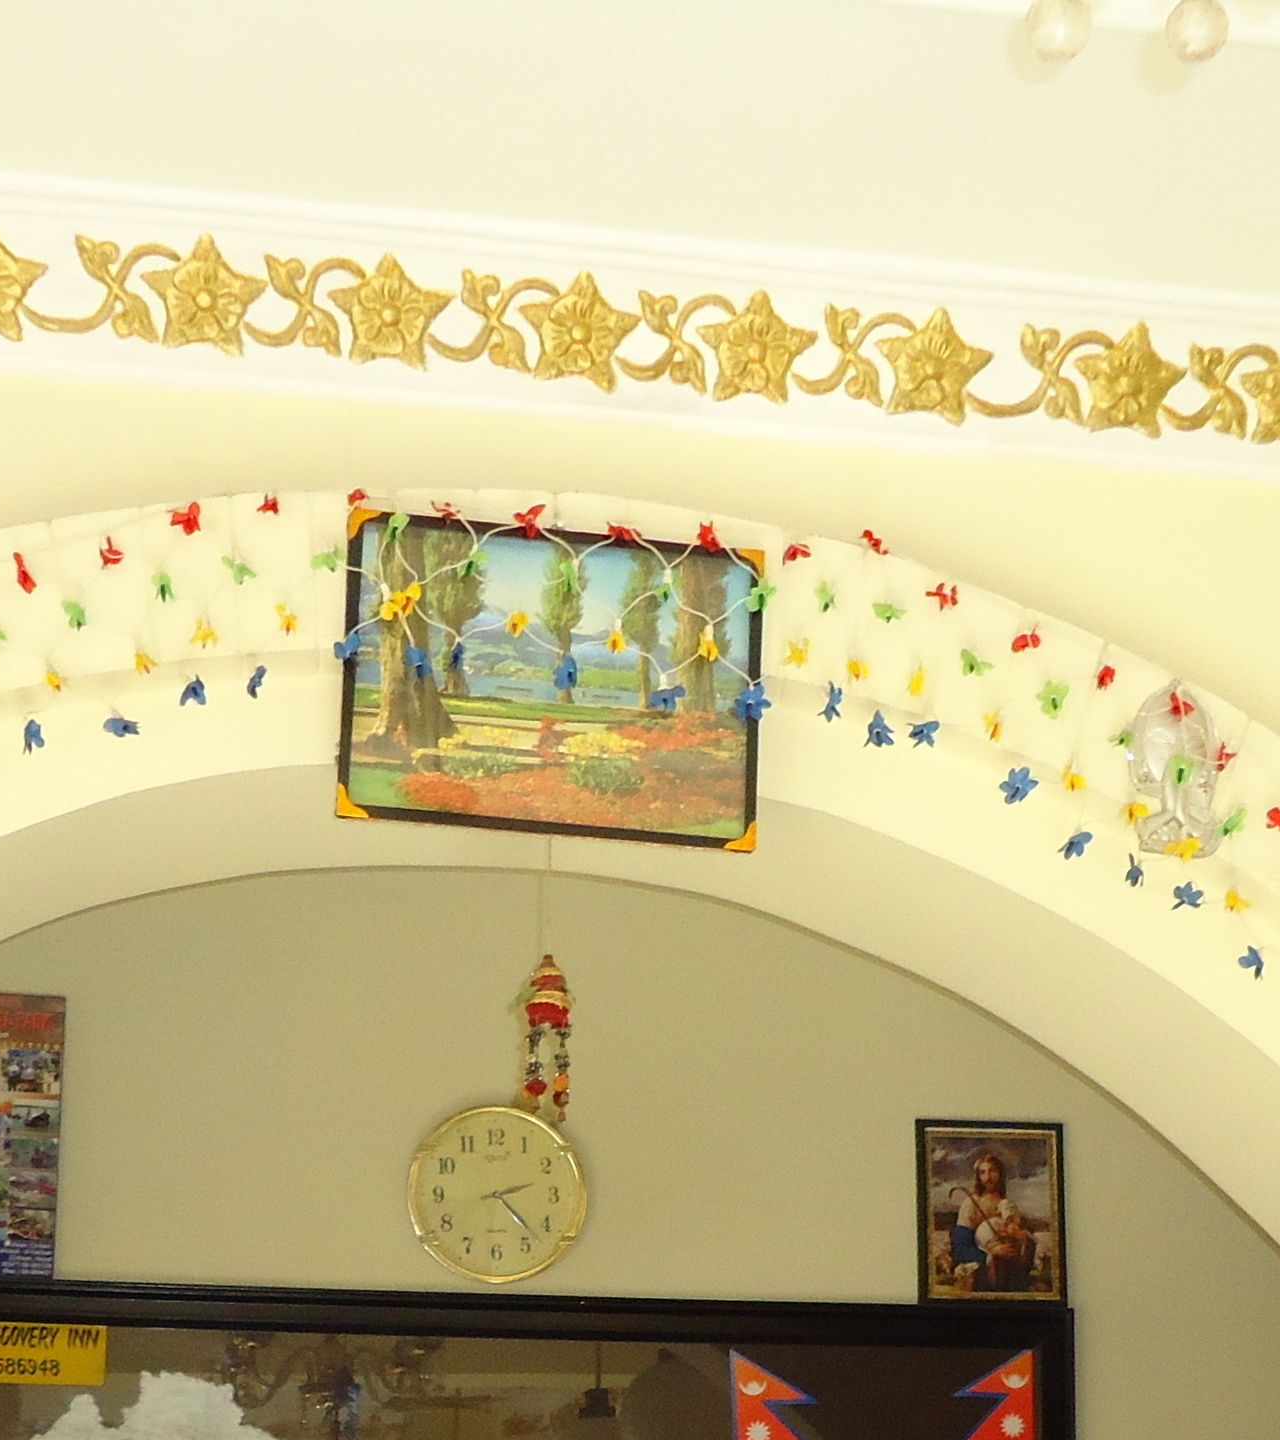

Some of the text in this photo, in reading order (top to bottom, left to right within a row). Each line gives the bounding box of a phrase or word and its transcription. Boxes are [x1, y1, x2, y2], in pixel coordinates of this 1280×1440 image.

[461, 1135, 474, 1153] 11
[487, 1129, 505, 1146] 12
[521, 1136, 527, 1154] 1
[439, 1157, 455, 1174] 10
[540, 1157, 552, 1174] 2
[433, 1185, 444, 1203] 9
[548, 1186, 560, 1204] 3
[440, 1213, 452, 1232] 8
[540, 1215, 551, 1232] 4
[462, 1236, 473, 1254] 7
[491, 1244, 502, 1260] 6
[520, 1237, 531, 1254] 5
[67, 1328, 100, 1349] INN
